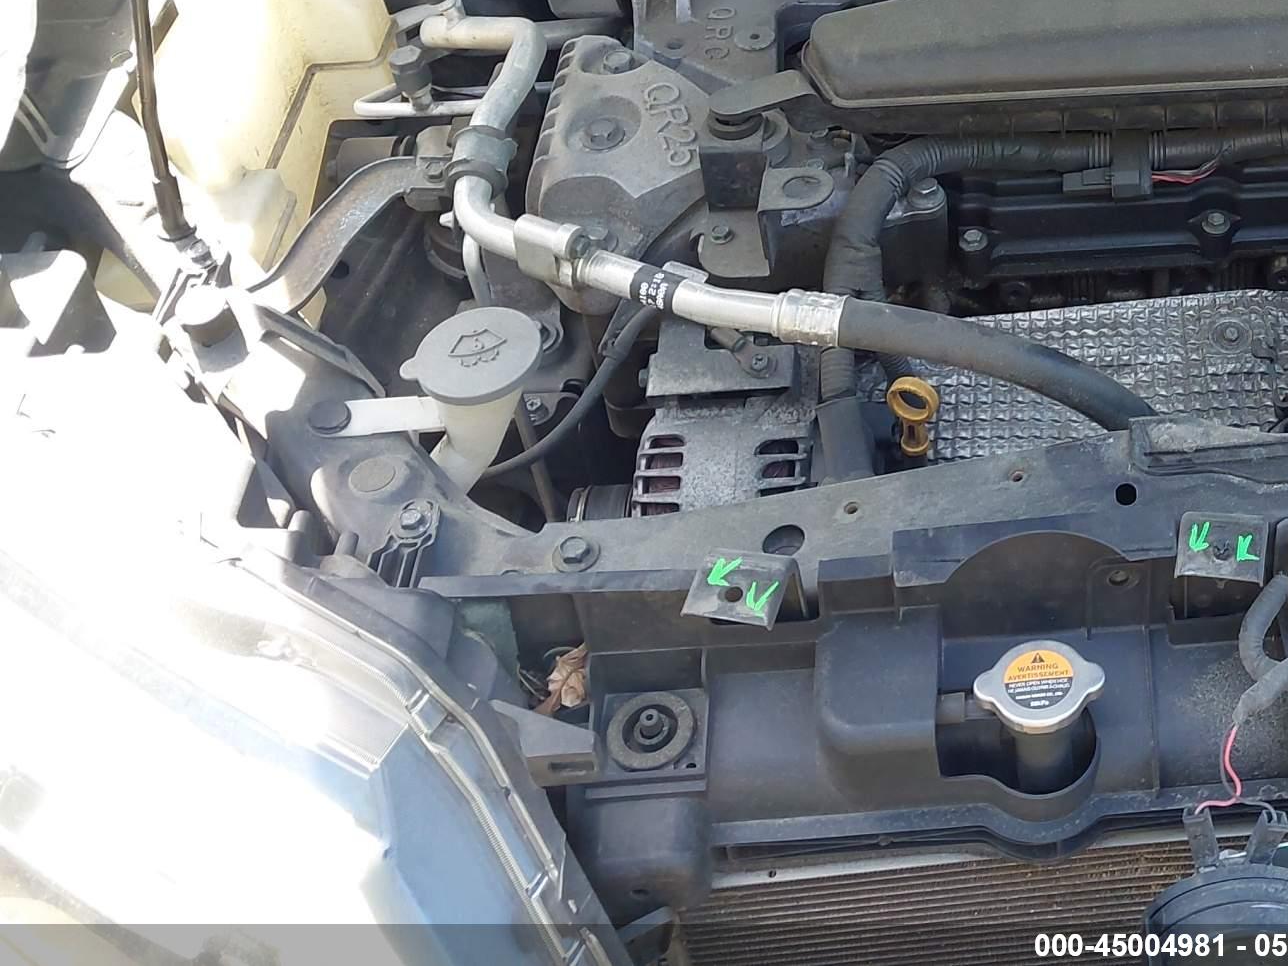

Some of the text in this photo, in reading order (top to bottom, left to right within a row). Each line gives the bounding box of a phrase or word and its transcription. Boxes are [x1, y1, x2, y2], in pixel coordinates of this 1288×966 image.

[644, 82, 699, 167] QR25
[1017, 663, 1059, 673] WARNING
[1008, 670, 1069, 681] AVERTISSEMENT
